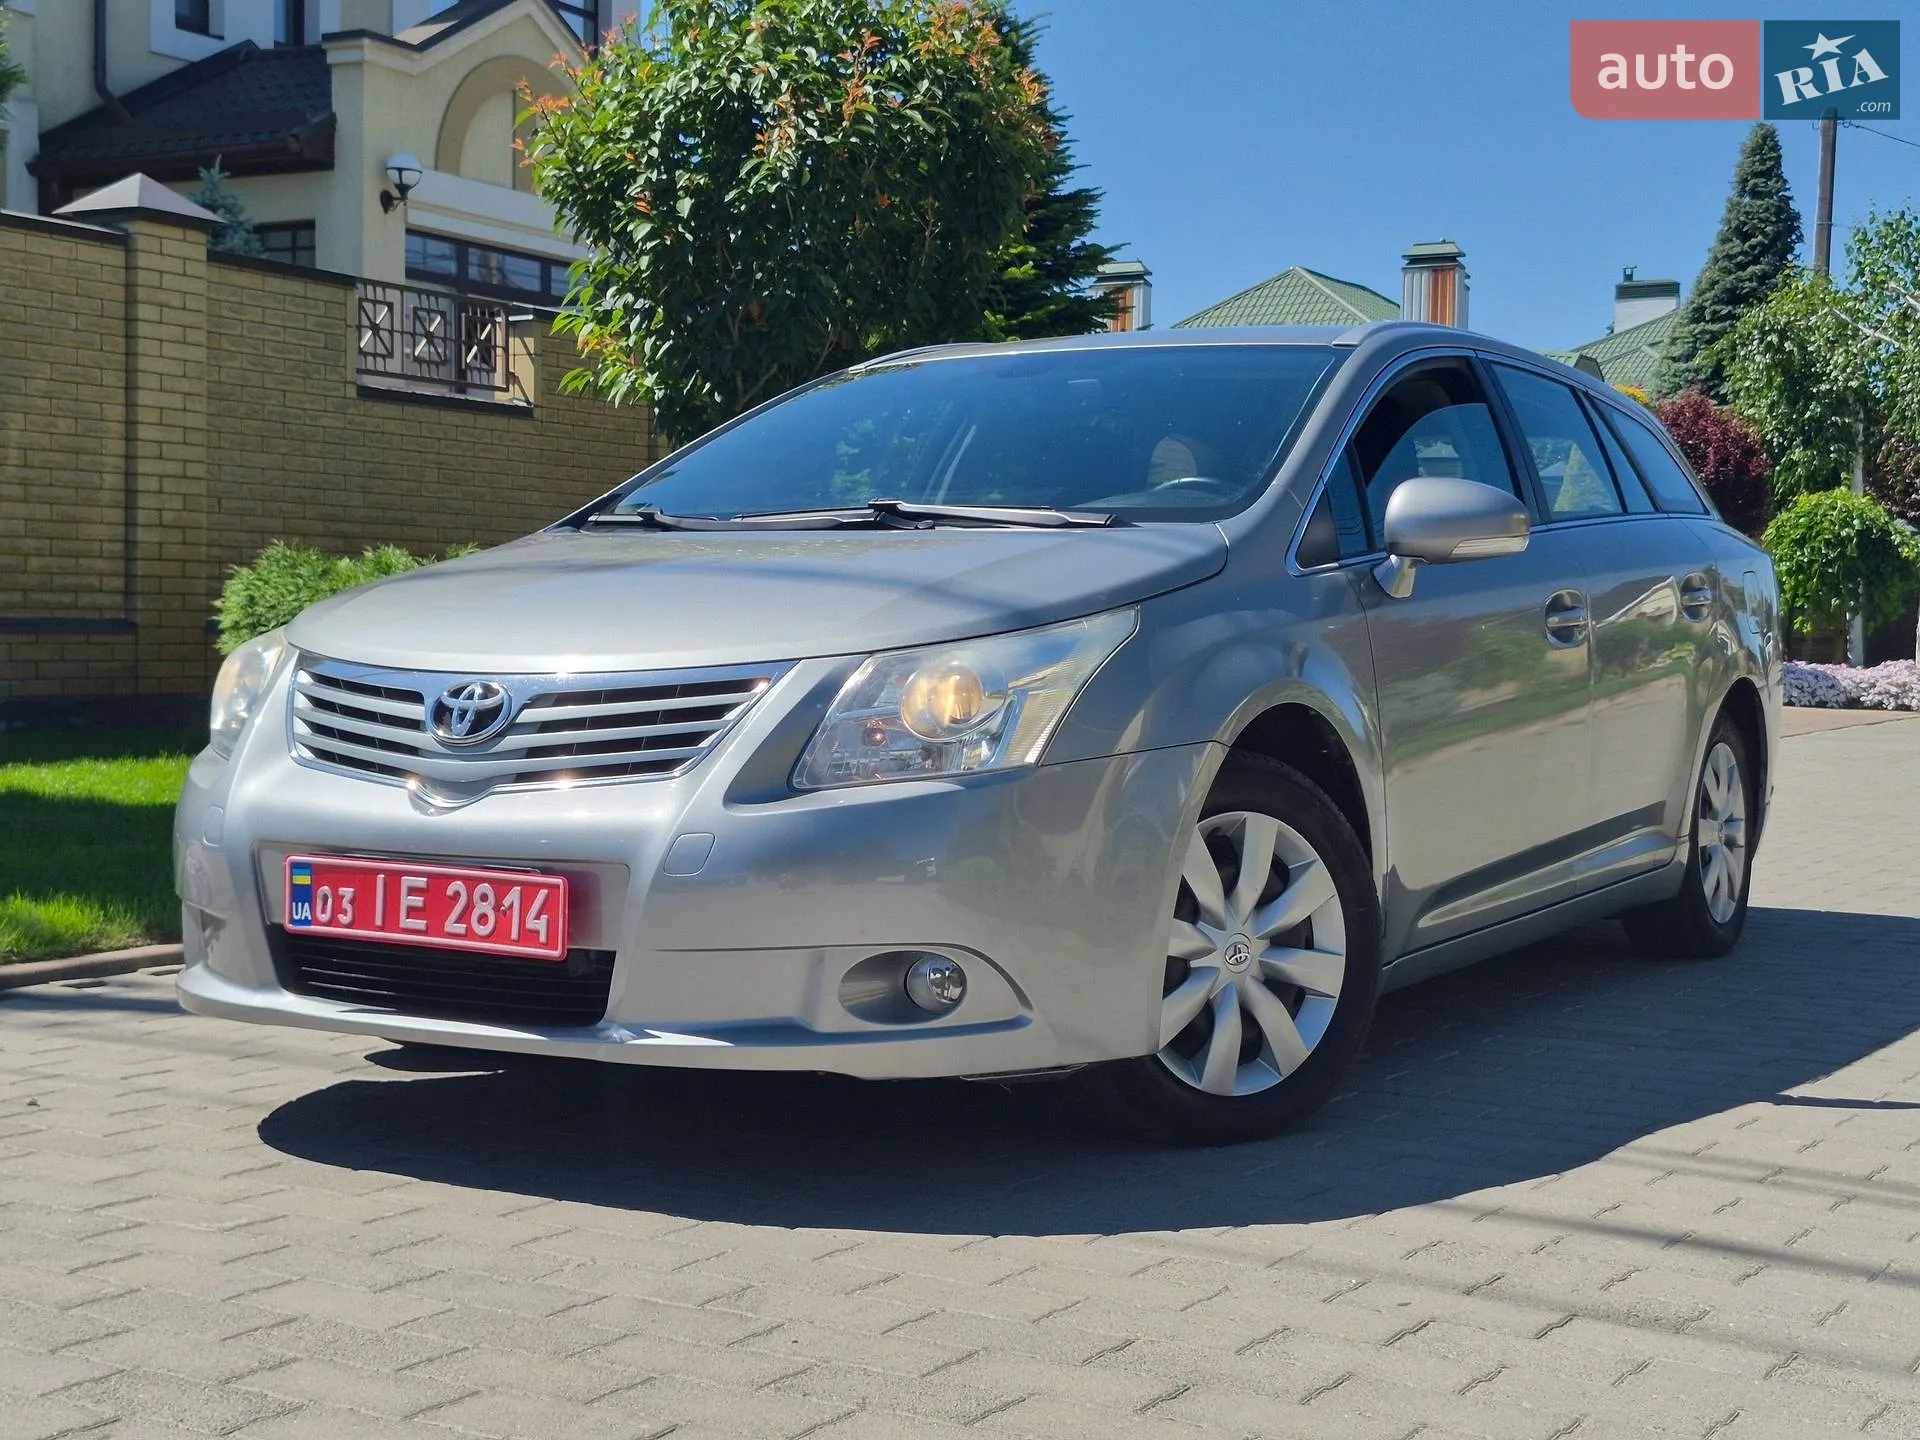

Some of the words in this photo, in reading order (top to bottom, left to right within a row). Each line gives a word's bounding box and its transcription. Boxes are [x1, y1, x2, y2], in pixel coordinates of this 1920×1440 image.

[292, 901, 312, 921] UA
[315, 885, 355, 926] 03
[444, 880, 549, 945] 2814
